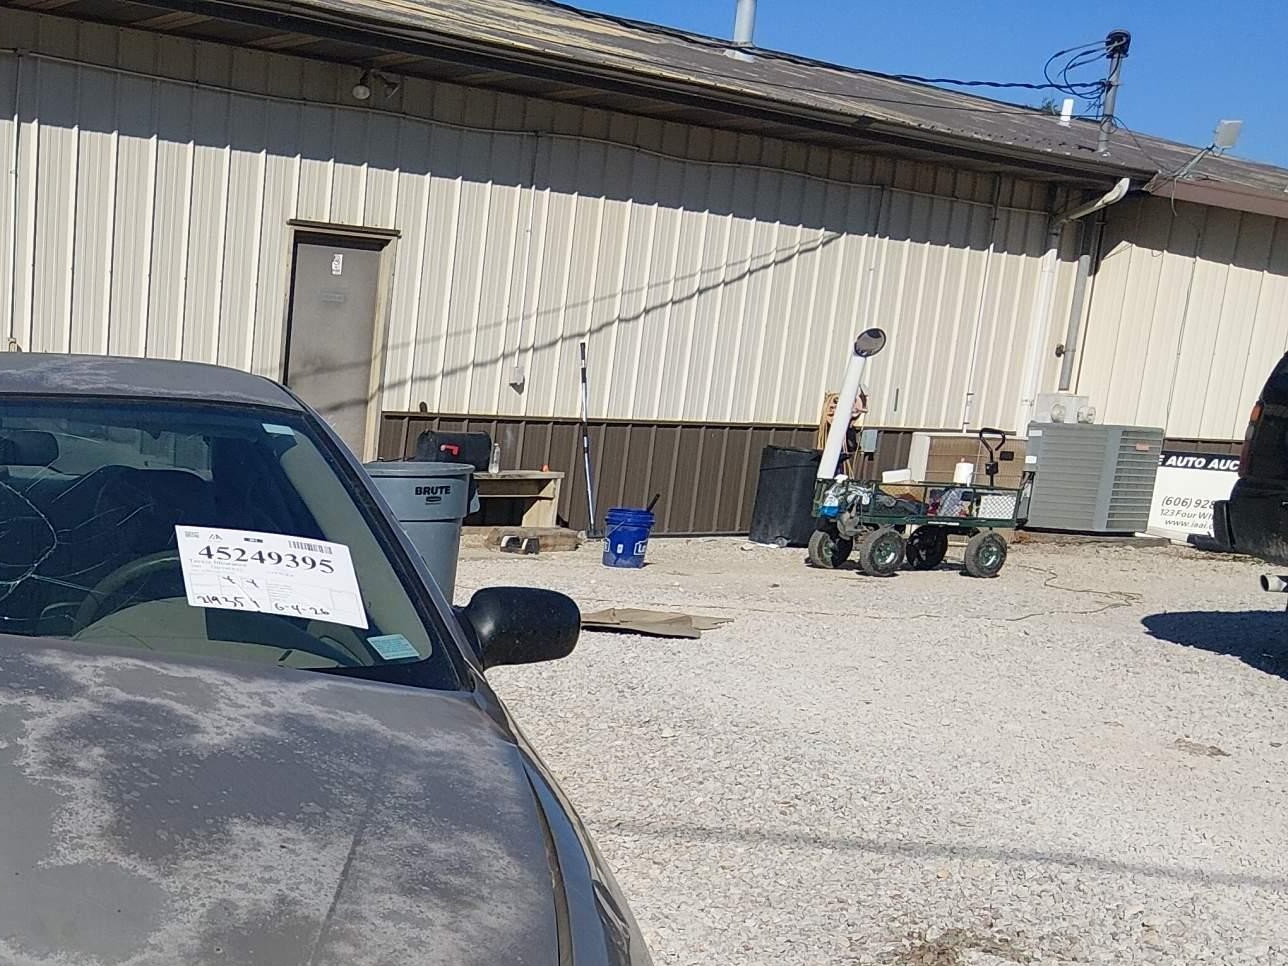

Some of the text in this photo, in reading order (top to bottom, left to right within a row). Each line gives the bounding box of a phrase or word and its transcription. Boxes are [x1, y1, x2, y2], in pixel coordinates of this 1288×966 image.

[1165, 456, 1206, 468] AUTO
[1207, 459, 1240, 470] AUC
[415, 486, 451, 496] BRUTE
[1161, 496, 1192, 509] (606)
[1160, 509, 1175, 517] 123
[1175, 510, 1197, 518] Four
[198, 545, 335, 574] 45249395
[274, 602, 330, 615] 6-4-26
